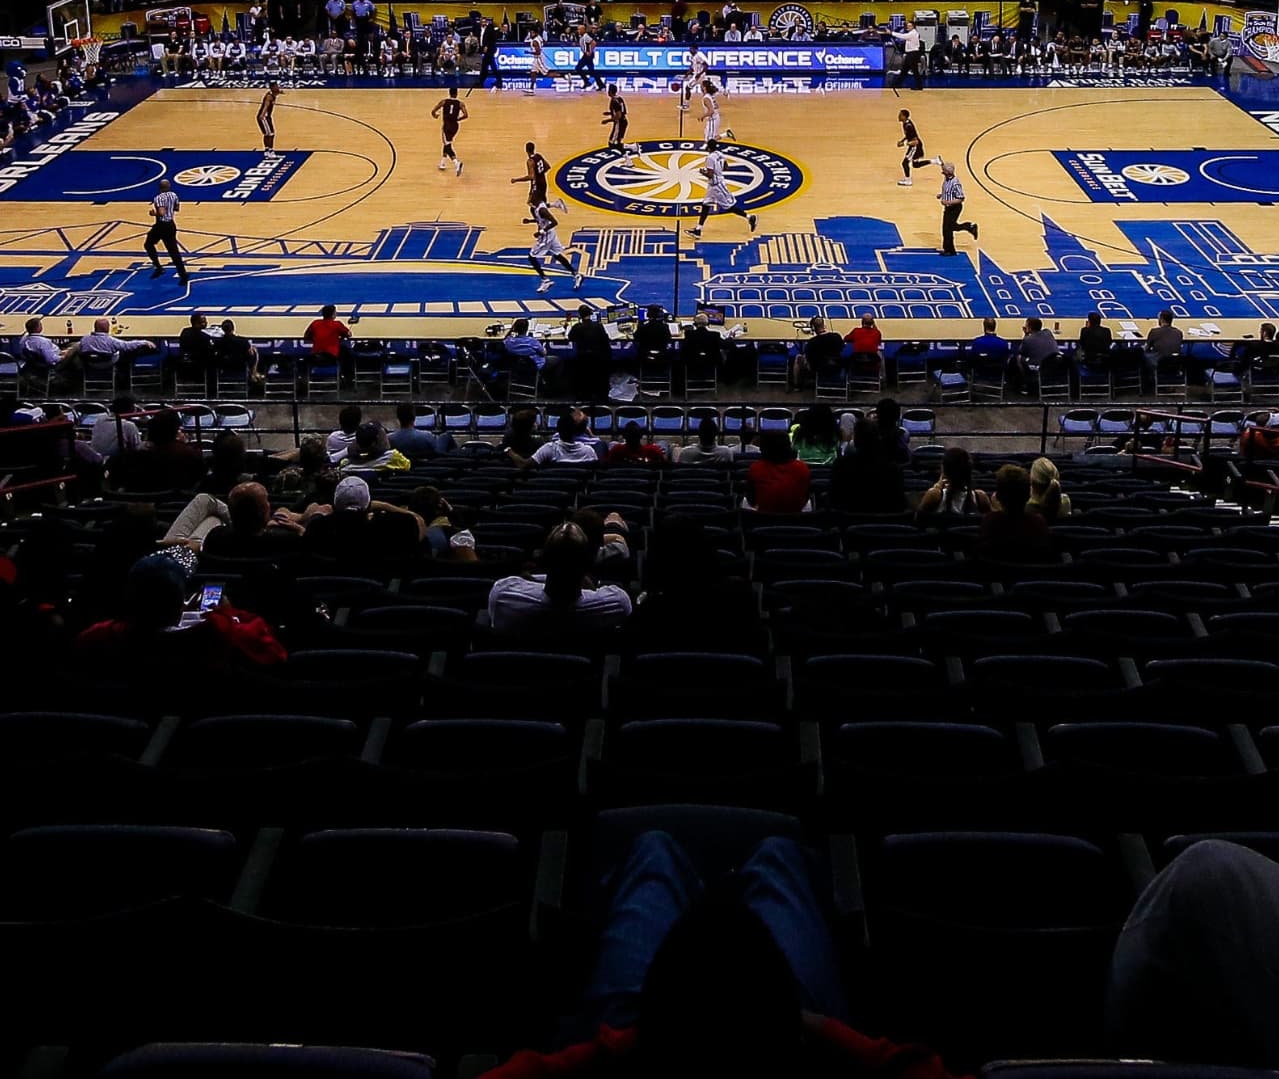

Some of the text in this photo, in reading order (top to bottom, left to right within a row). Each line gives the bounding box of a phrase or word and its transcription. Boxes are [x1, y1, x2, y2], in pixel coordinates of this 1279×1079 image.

[498, 54, 535, 65] Ochsne
[606, 51, 663, 66] BELT
[222, 154, 287, 199] SUN BELT
[567, 166, 590, 190] SUN
[1076, 153, 1139, 202] SUN BELT
[624, 202, 718, 214] EST 197
